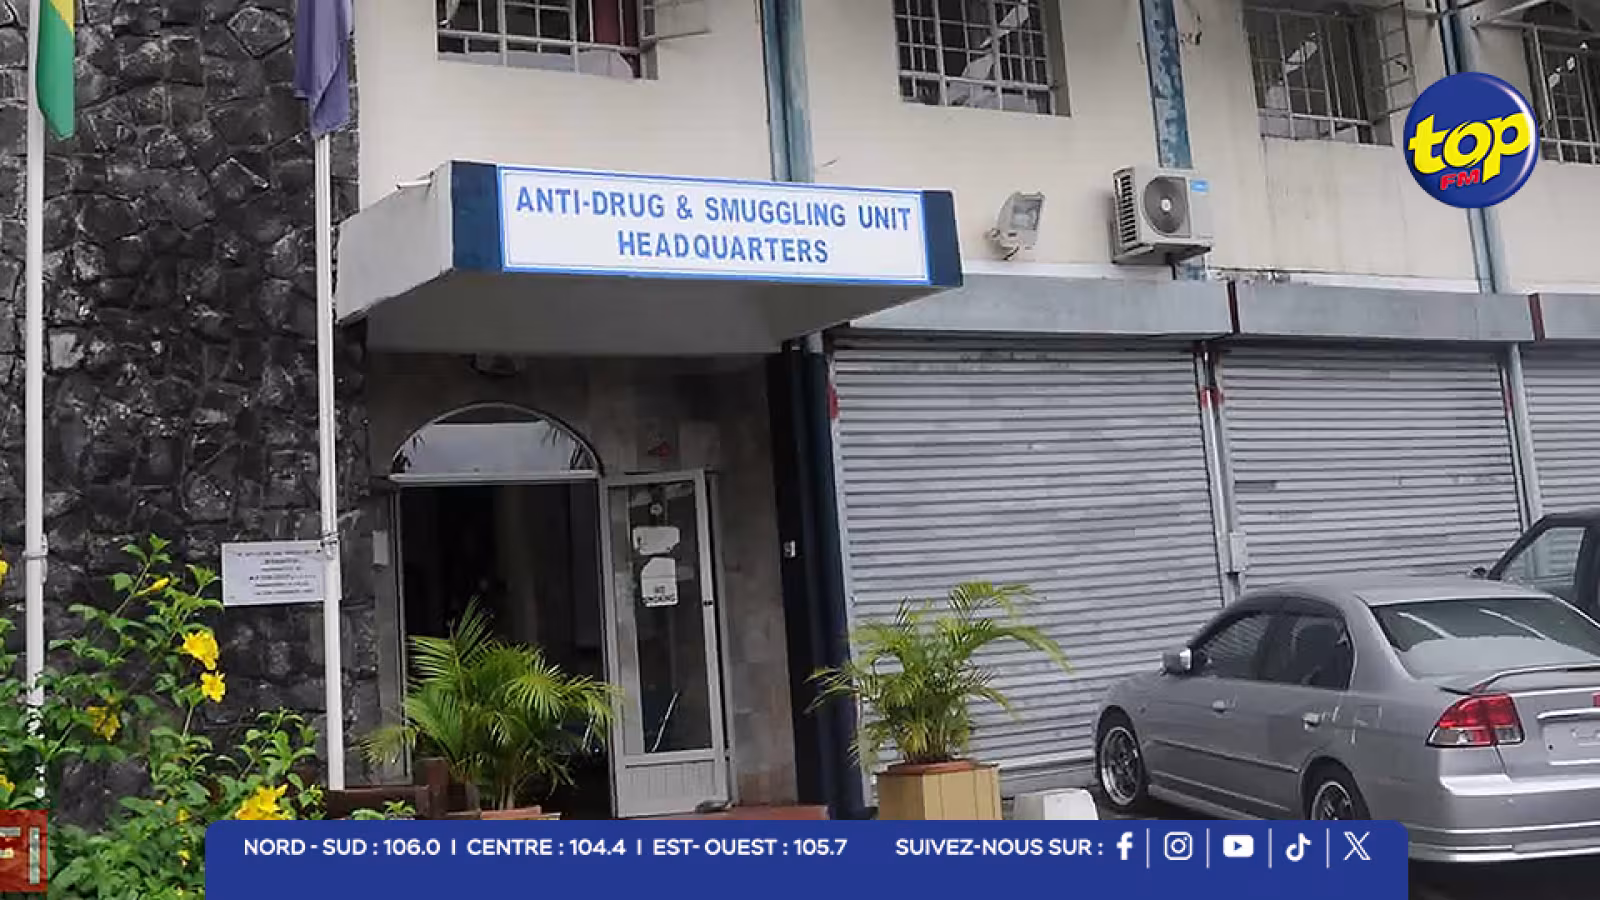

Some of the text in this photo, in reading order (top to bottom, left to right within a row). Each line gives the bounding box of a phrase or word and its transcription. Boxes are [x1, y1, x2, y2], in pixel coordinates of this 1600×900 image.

[516, 185, 912, 231] ANTI-DRUG & SMUGGLING UNIT
[617, 230, 829, 264] HEADQUARTERS
